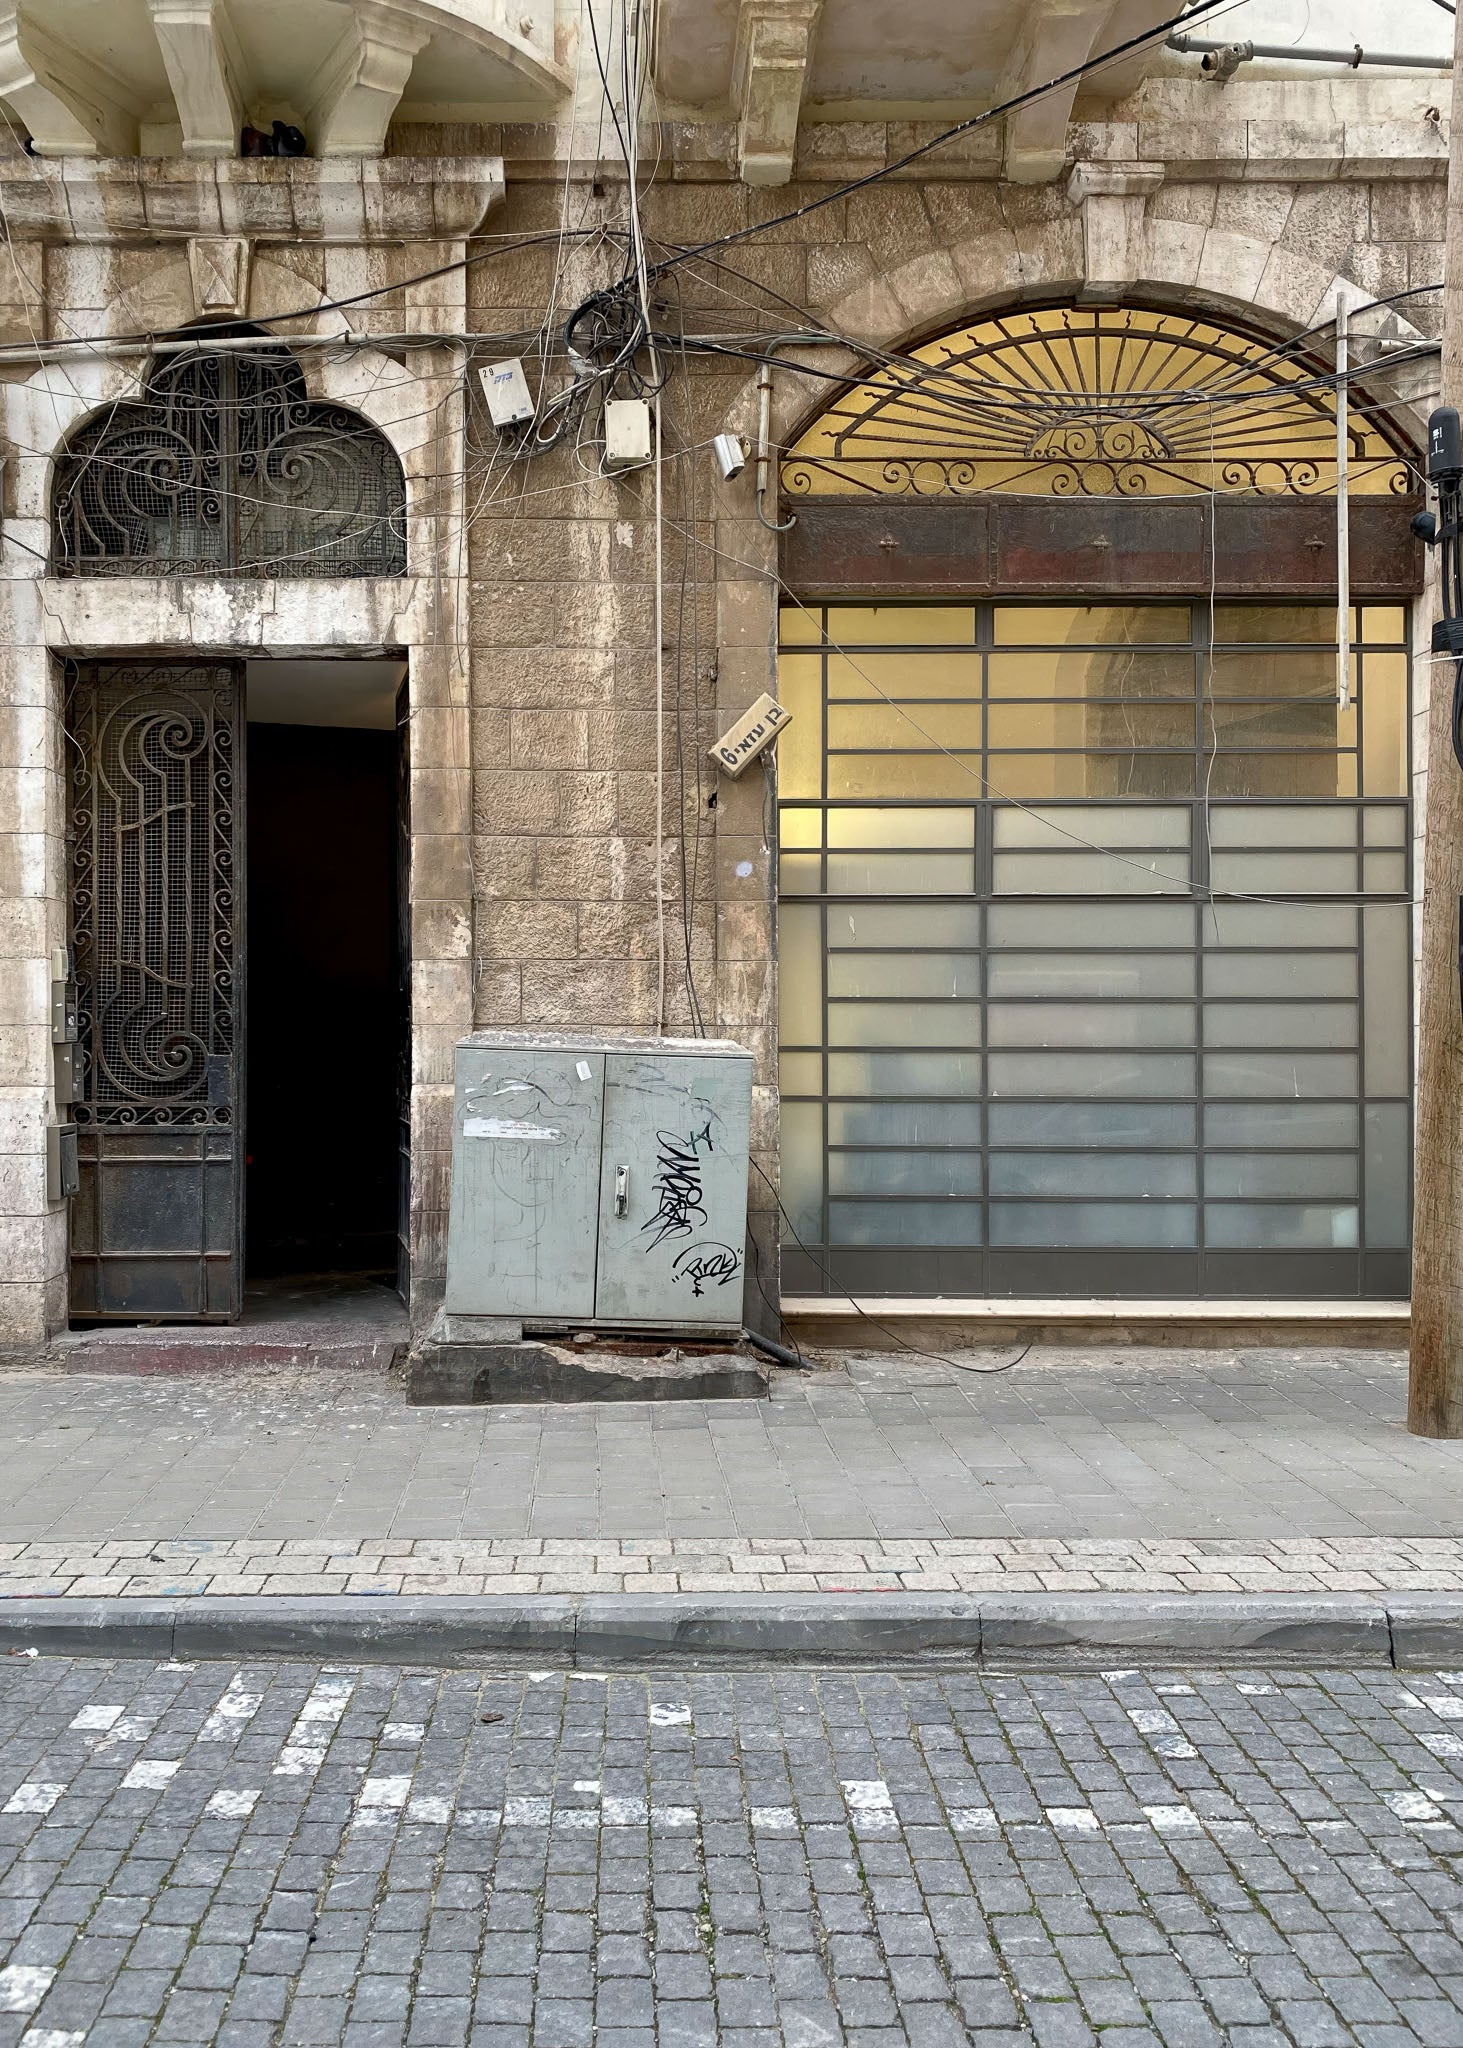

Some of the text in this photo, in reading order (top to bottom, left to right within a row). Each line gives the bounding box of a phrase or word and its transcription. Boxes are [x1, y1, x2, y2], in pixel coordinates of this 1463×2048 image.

[720, 707, 783, 765] בן עזאי 6
